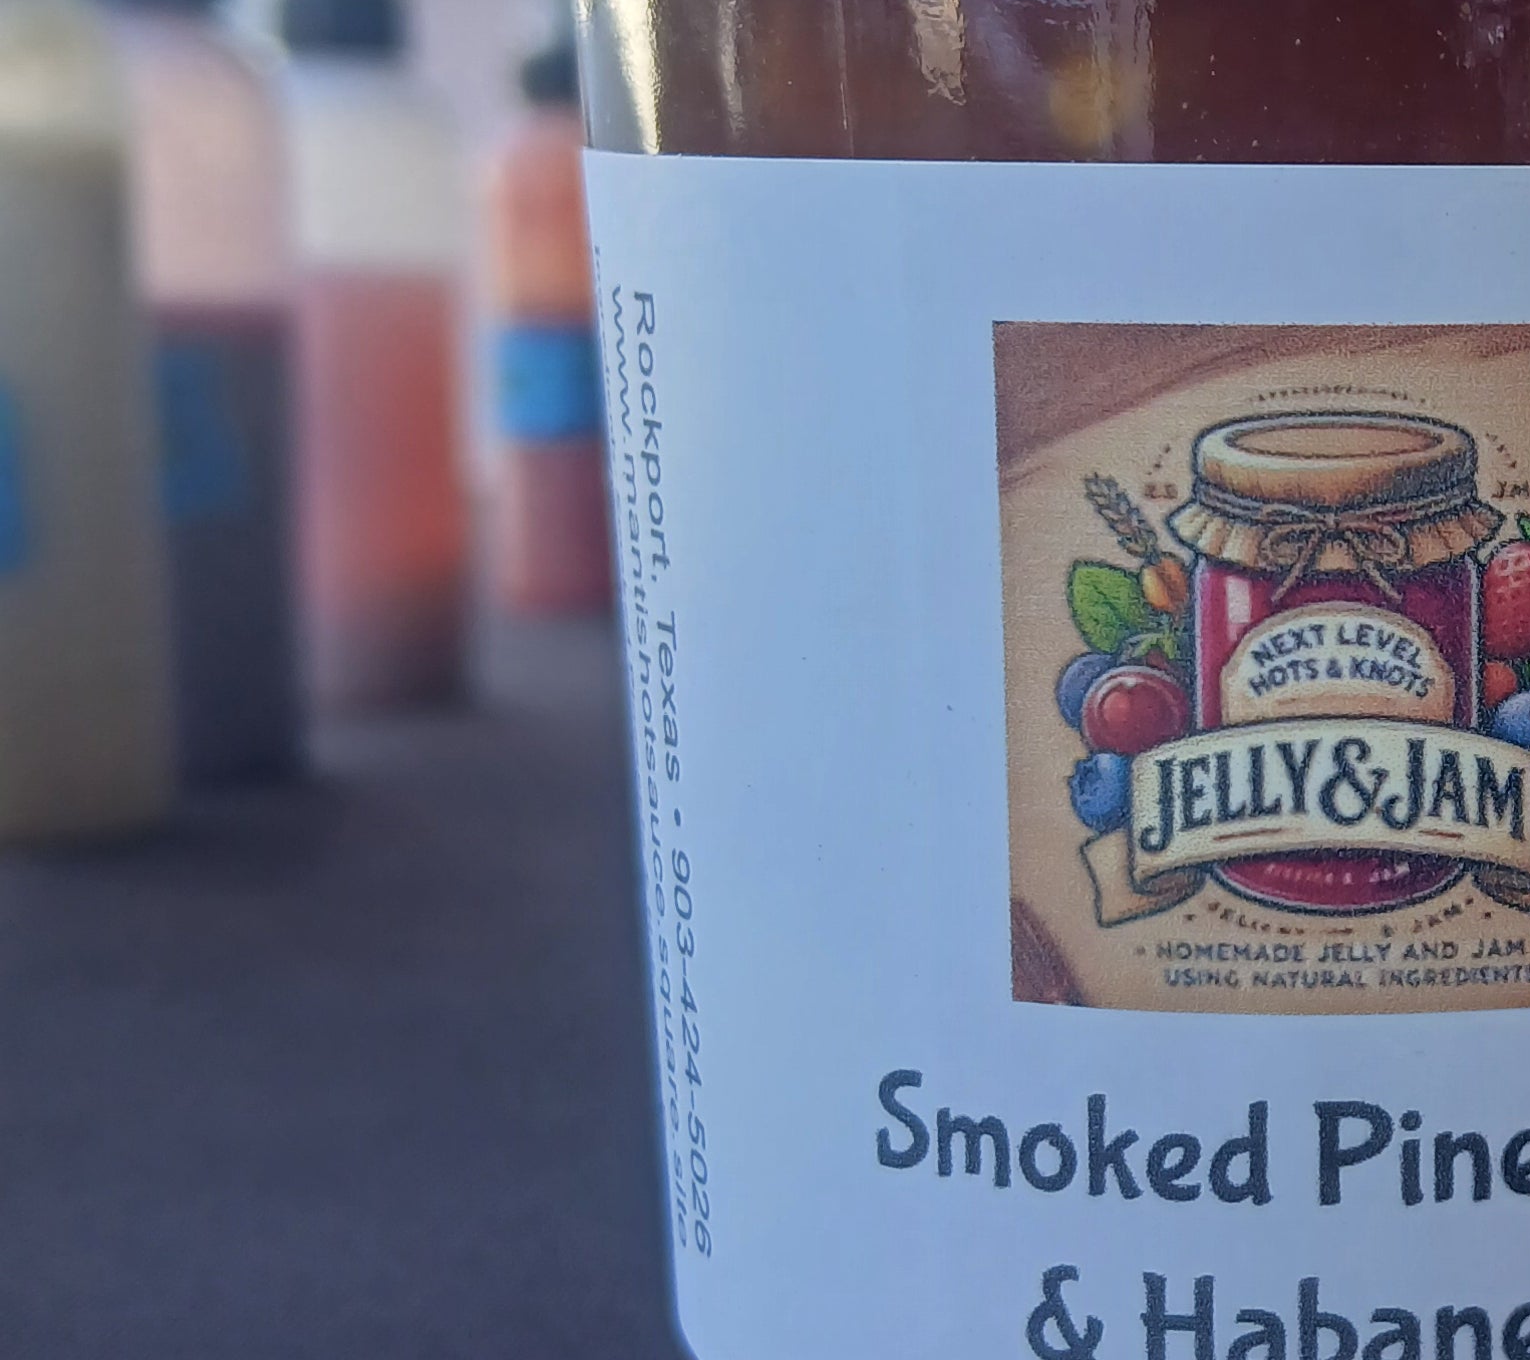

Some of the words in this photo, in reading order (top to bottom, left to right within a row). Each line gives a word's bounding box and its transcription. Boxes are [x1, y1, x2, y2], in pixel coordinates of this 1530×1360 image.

[1251, 624, 1325, 667] NEXT
[1337, 623, 1421, 669] LEVEL
[1249, 659, 1319, 697] HOTS
[1326, 658, 1342, 679] &
[1351, 656, 1435, 698] KNOTS
[634, 291, 671, 583] Rockport,
[656, 612, 681, 783] Texas
[671, 849, 712, 1259] 903-424-5026
[1155, 939, 1306, 963] HOMEMADE
[1317, 942, 1392, 963] JELLY
[1402, 941, 1459, 962] AND
[1471, 938, 1530, 959] JAM
[1164, 968, 1239, 988] USING
[1252, 967, 1369, 988] NATURAL
[875, 1068, 1274, 1205] Smoked
